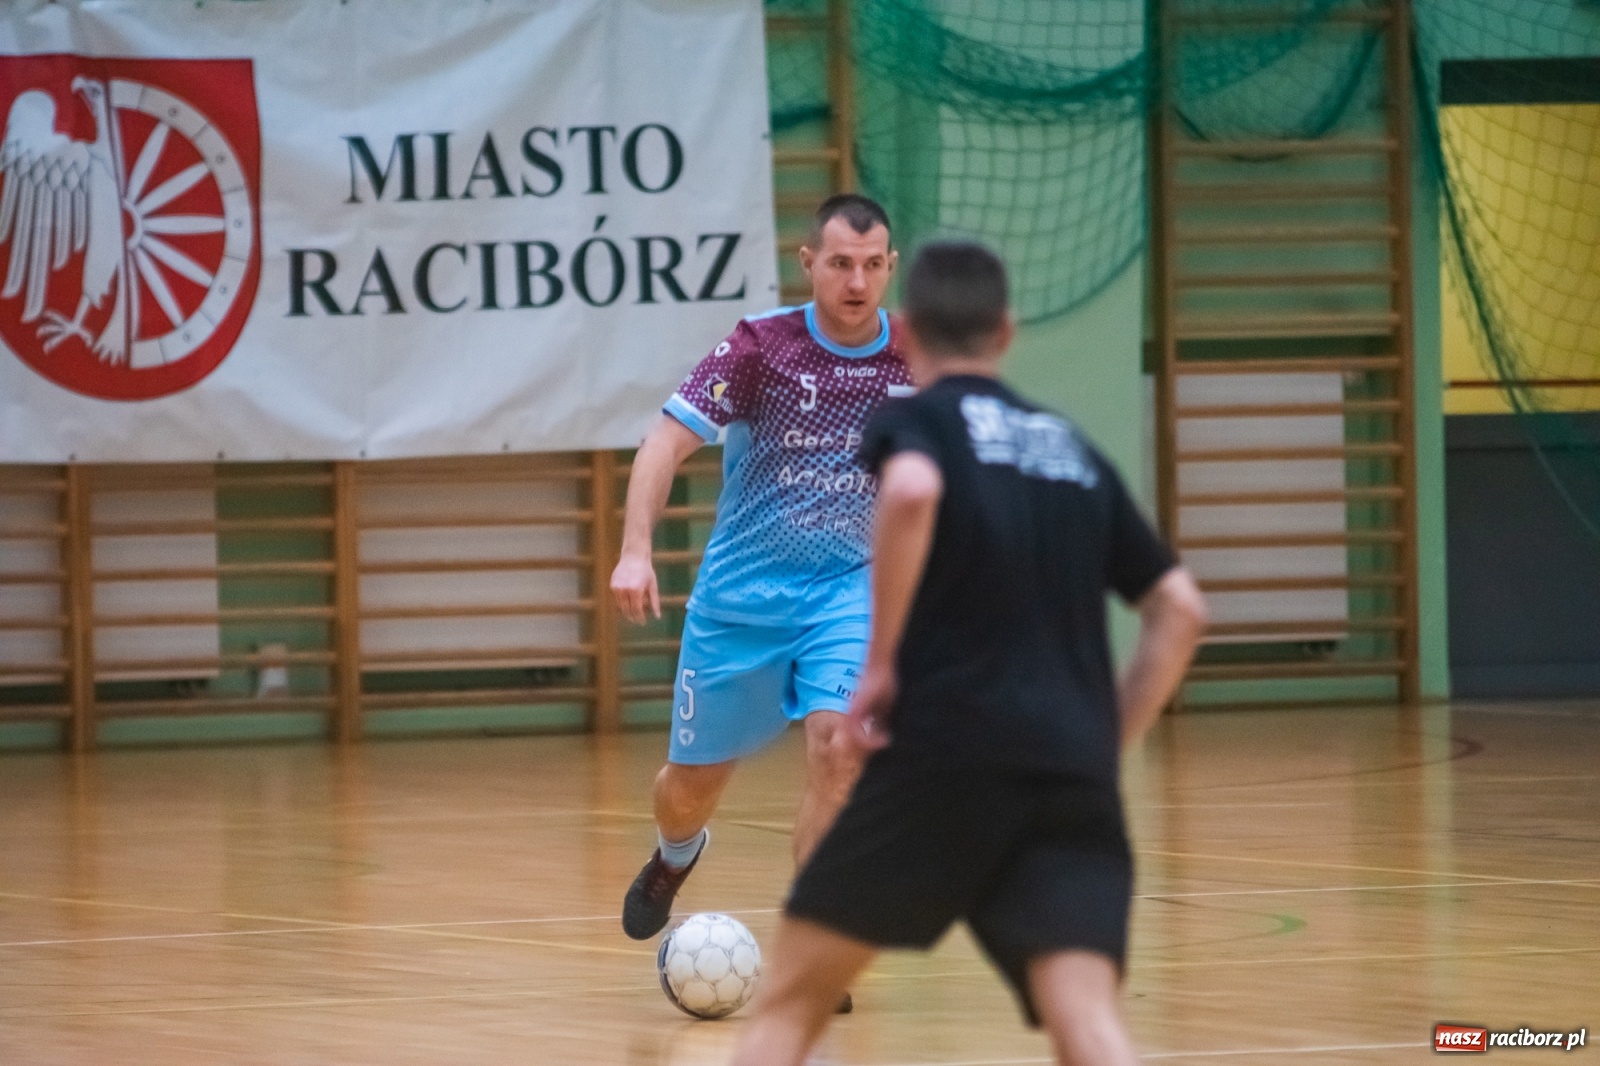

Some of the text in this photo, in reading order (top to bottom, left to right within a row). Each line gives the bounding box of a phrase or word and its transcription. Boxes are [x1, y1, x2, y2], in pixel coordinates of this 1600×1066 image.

[341, 122, 685, 204] MIASTO
[283, 214, 747, 318] RACIBÓRZ
[799, 373, 817, 412] 5
[679, 668, 697, 722] 5
